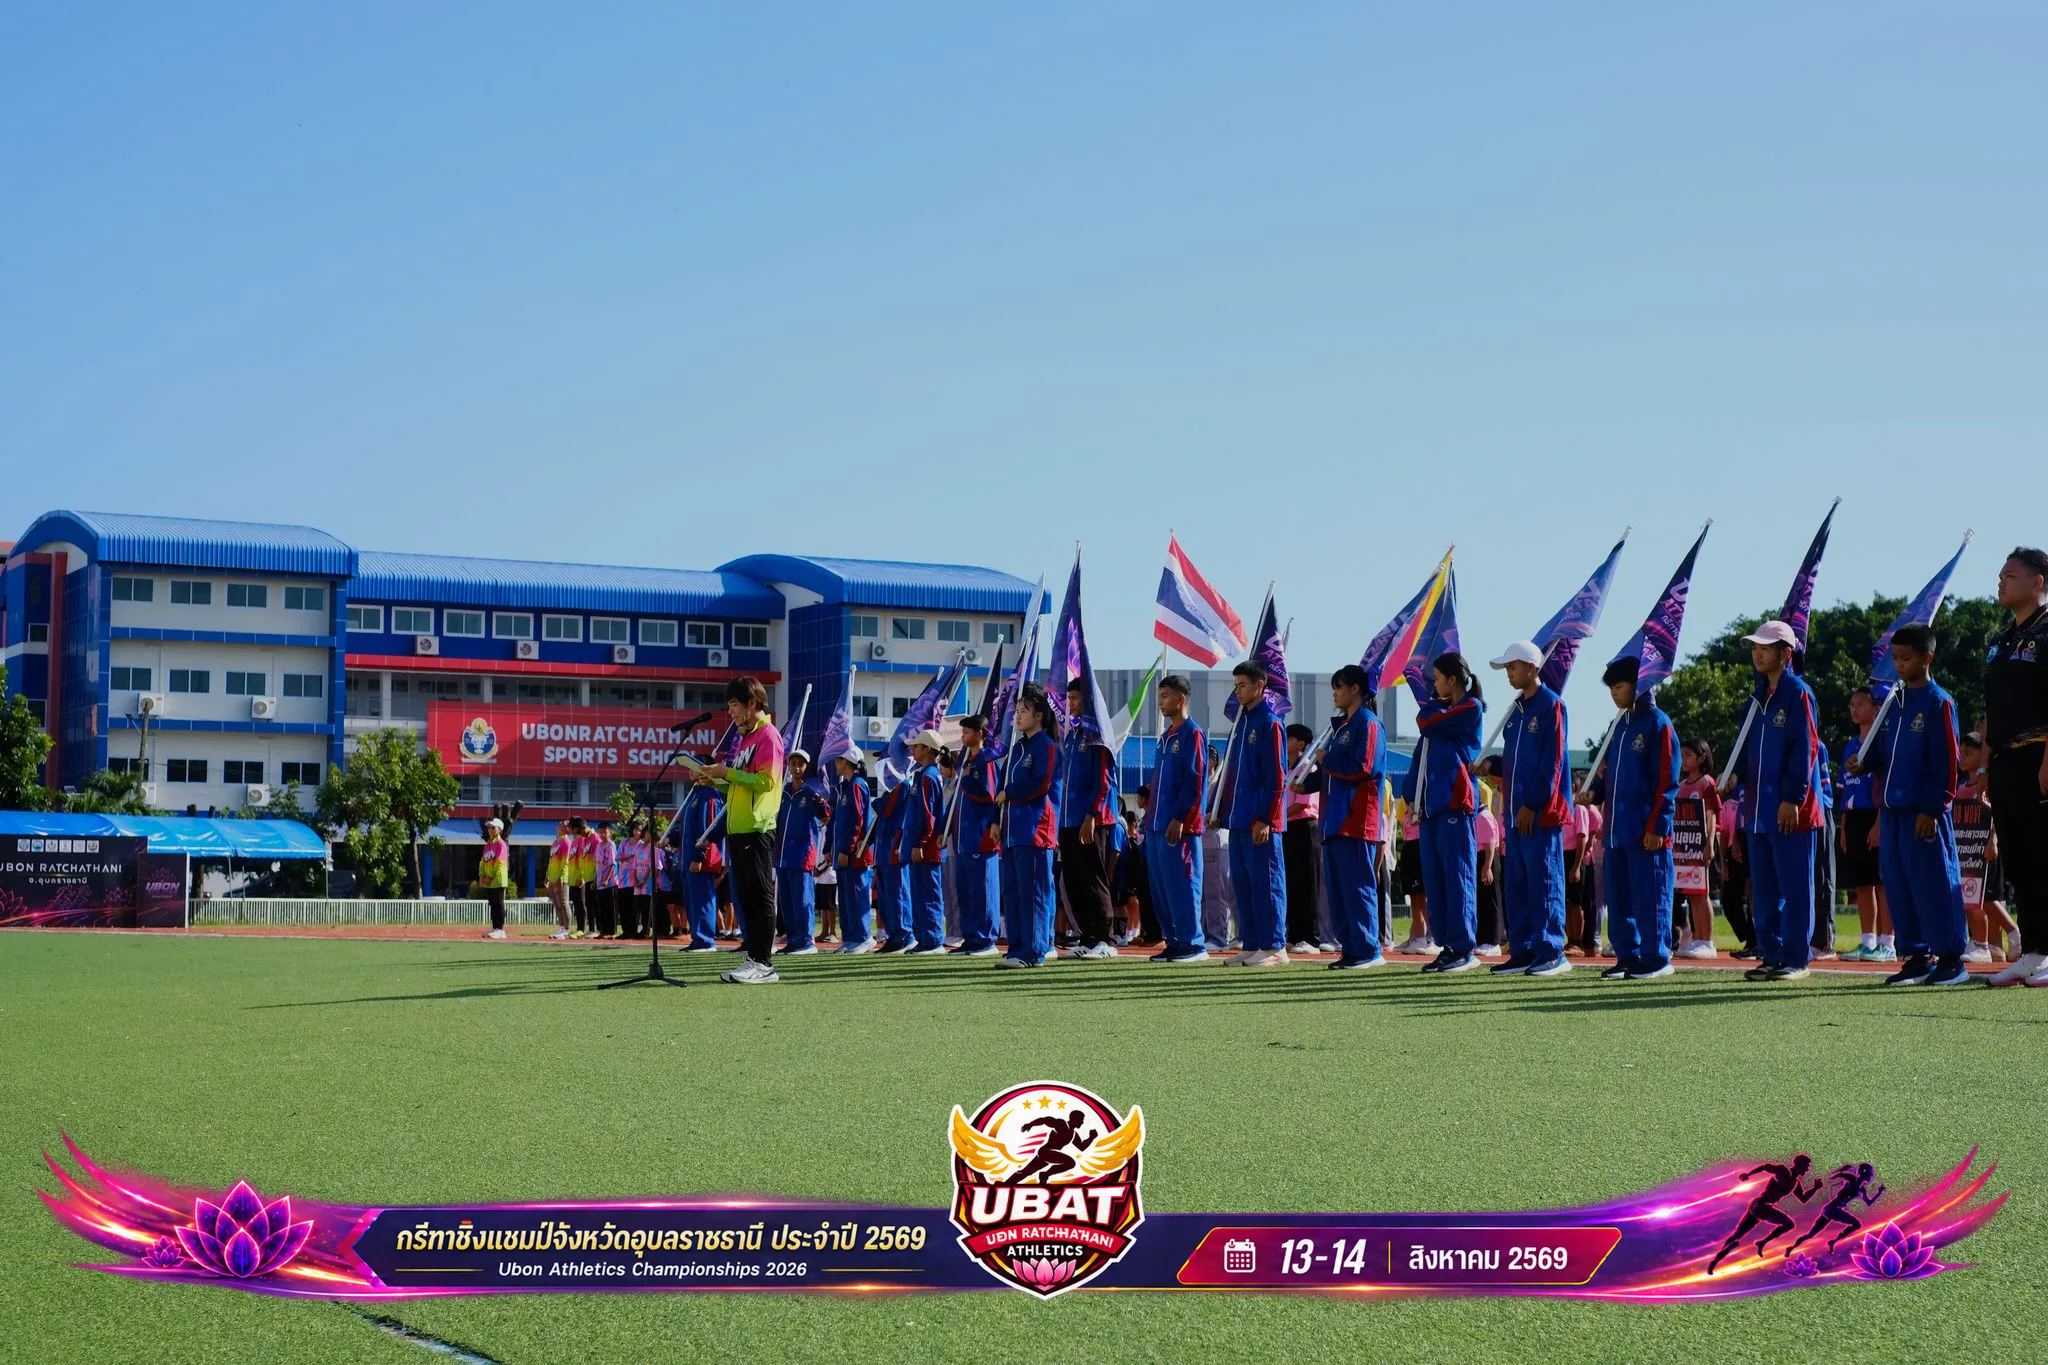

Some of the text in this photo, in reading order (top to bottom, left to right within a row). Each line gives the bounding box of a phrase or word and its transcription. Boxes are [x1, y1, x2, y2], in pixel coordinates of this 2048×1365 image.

[522, 723, 716, 746] UBONRATCHATHANI
[544, 746, 618, 765] SPORTS
[40, 863, 122, 873] RATCHATHANI
